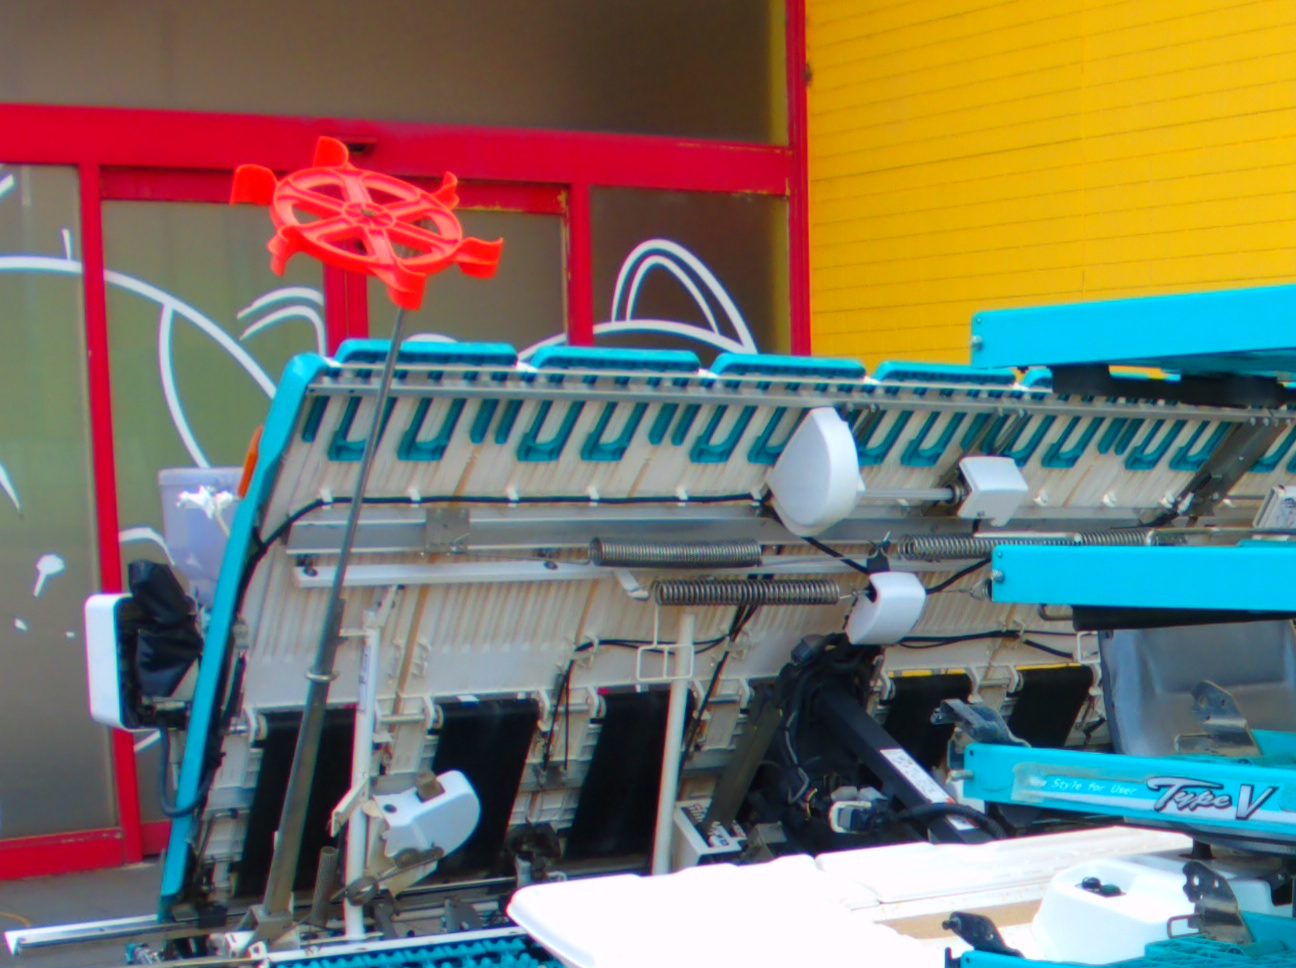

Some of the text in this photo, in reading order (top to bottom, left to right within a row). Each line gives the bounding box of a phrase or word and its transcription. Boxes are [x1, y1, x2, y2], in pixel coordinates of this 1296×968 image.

[1051, 778, 1082, 791] Style
[1110, 783, 1138, 795] User
[1146, 776, 1279, 820] Type V
